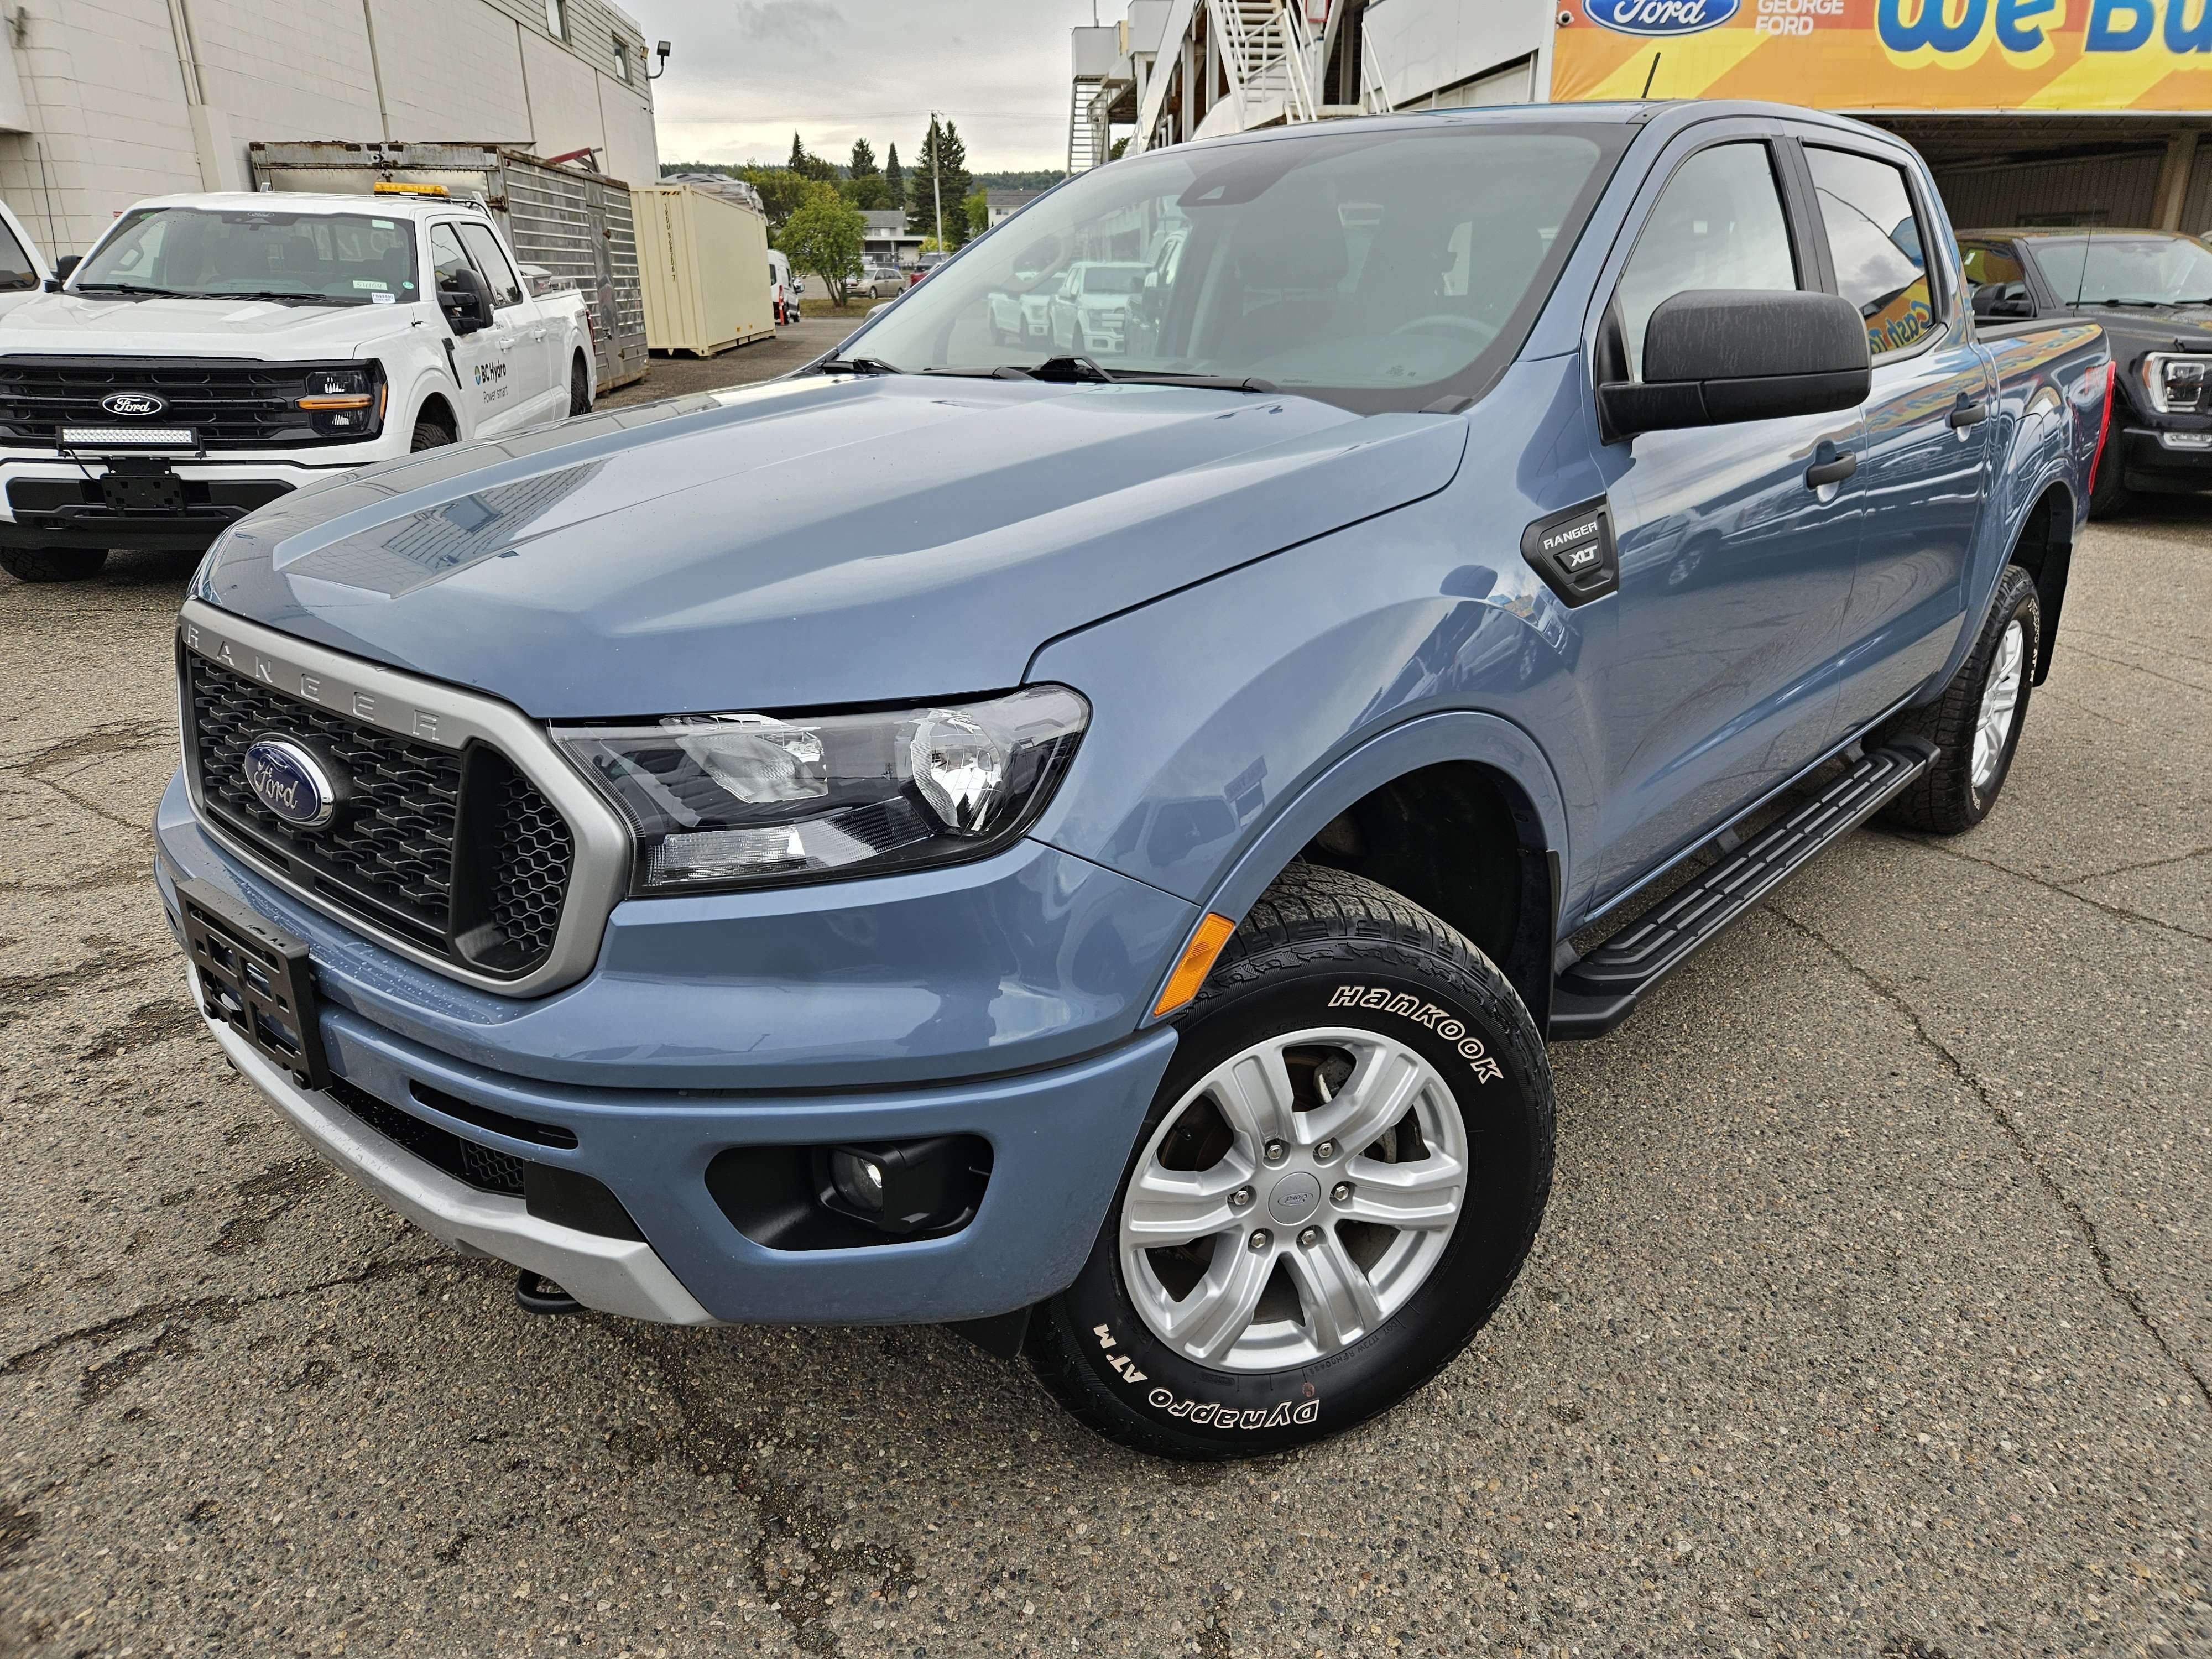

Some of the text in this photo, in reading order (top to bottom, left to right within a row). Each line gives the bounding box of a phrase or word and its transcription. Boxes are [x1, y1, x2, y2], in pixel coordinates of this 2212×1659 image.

[1757, 0, 1844, 14] GEORGE
[1755, 15, 1814, 35] FORD
[481, 359, 506, 383] BC Hydro
[114, 398, 150, 412] Ford
[483, 385, 508, 404] Power smart
[1543, 521, 1598, 550] RANGER
[1568, 544, 1598, 567] XLT
[187, 623, 440, 742] RANGER
[254, 753, 299, 810] Ford
[1149, 1387, 1320, 1430] Dynapro
